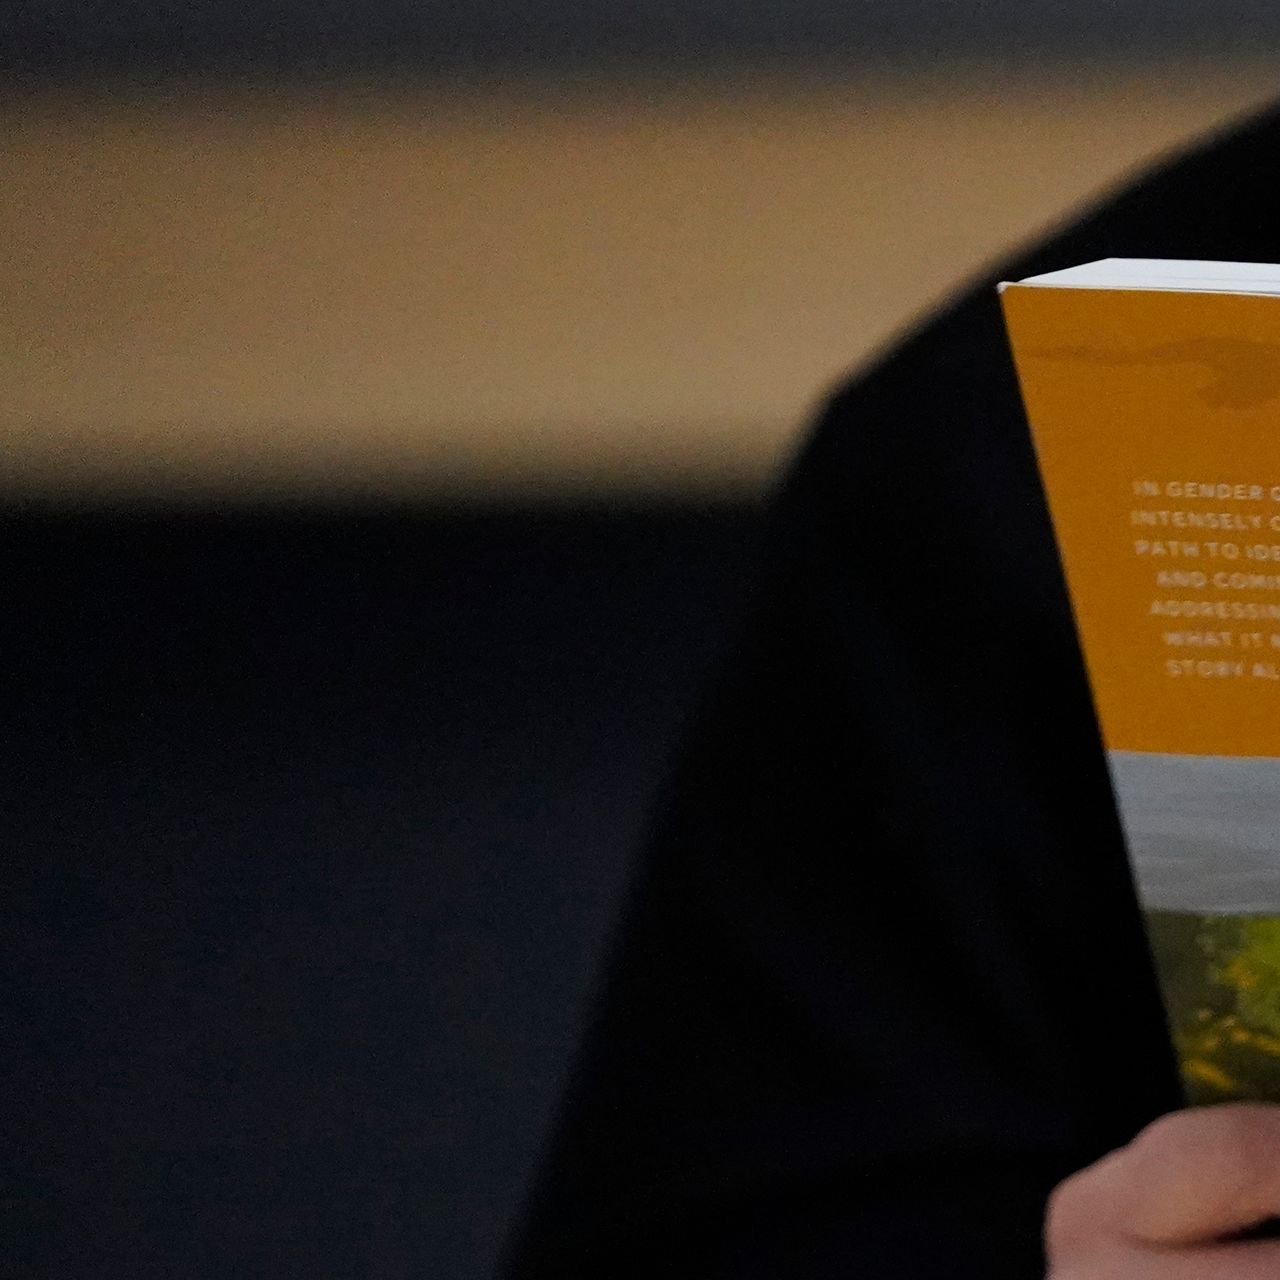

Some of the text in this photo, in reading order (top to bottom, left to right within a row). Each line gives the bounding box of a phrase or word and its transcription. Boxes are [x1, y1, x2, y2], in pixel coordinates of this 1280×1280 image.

[1165, 481, 1264, 500] GENDER
[1130, 510, 1262, 530] INTENSELY
[1134, 539, 1200, 558] PATH
[1204, 541, 1240, 560] TO
